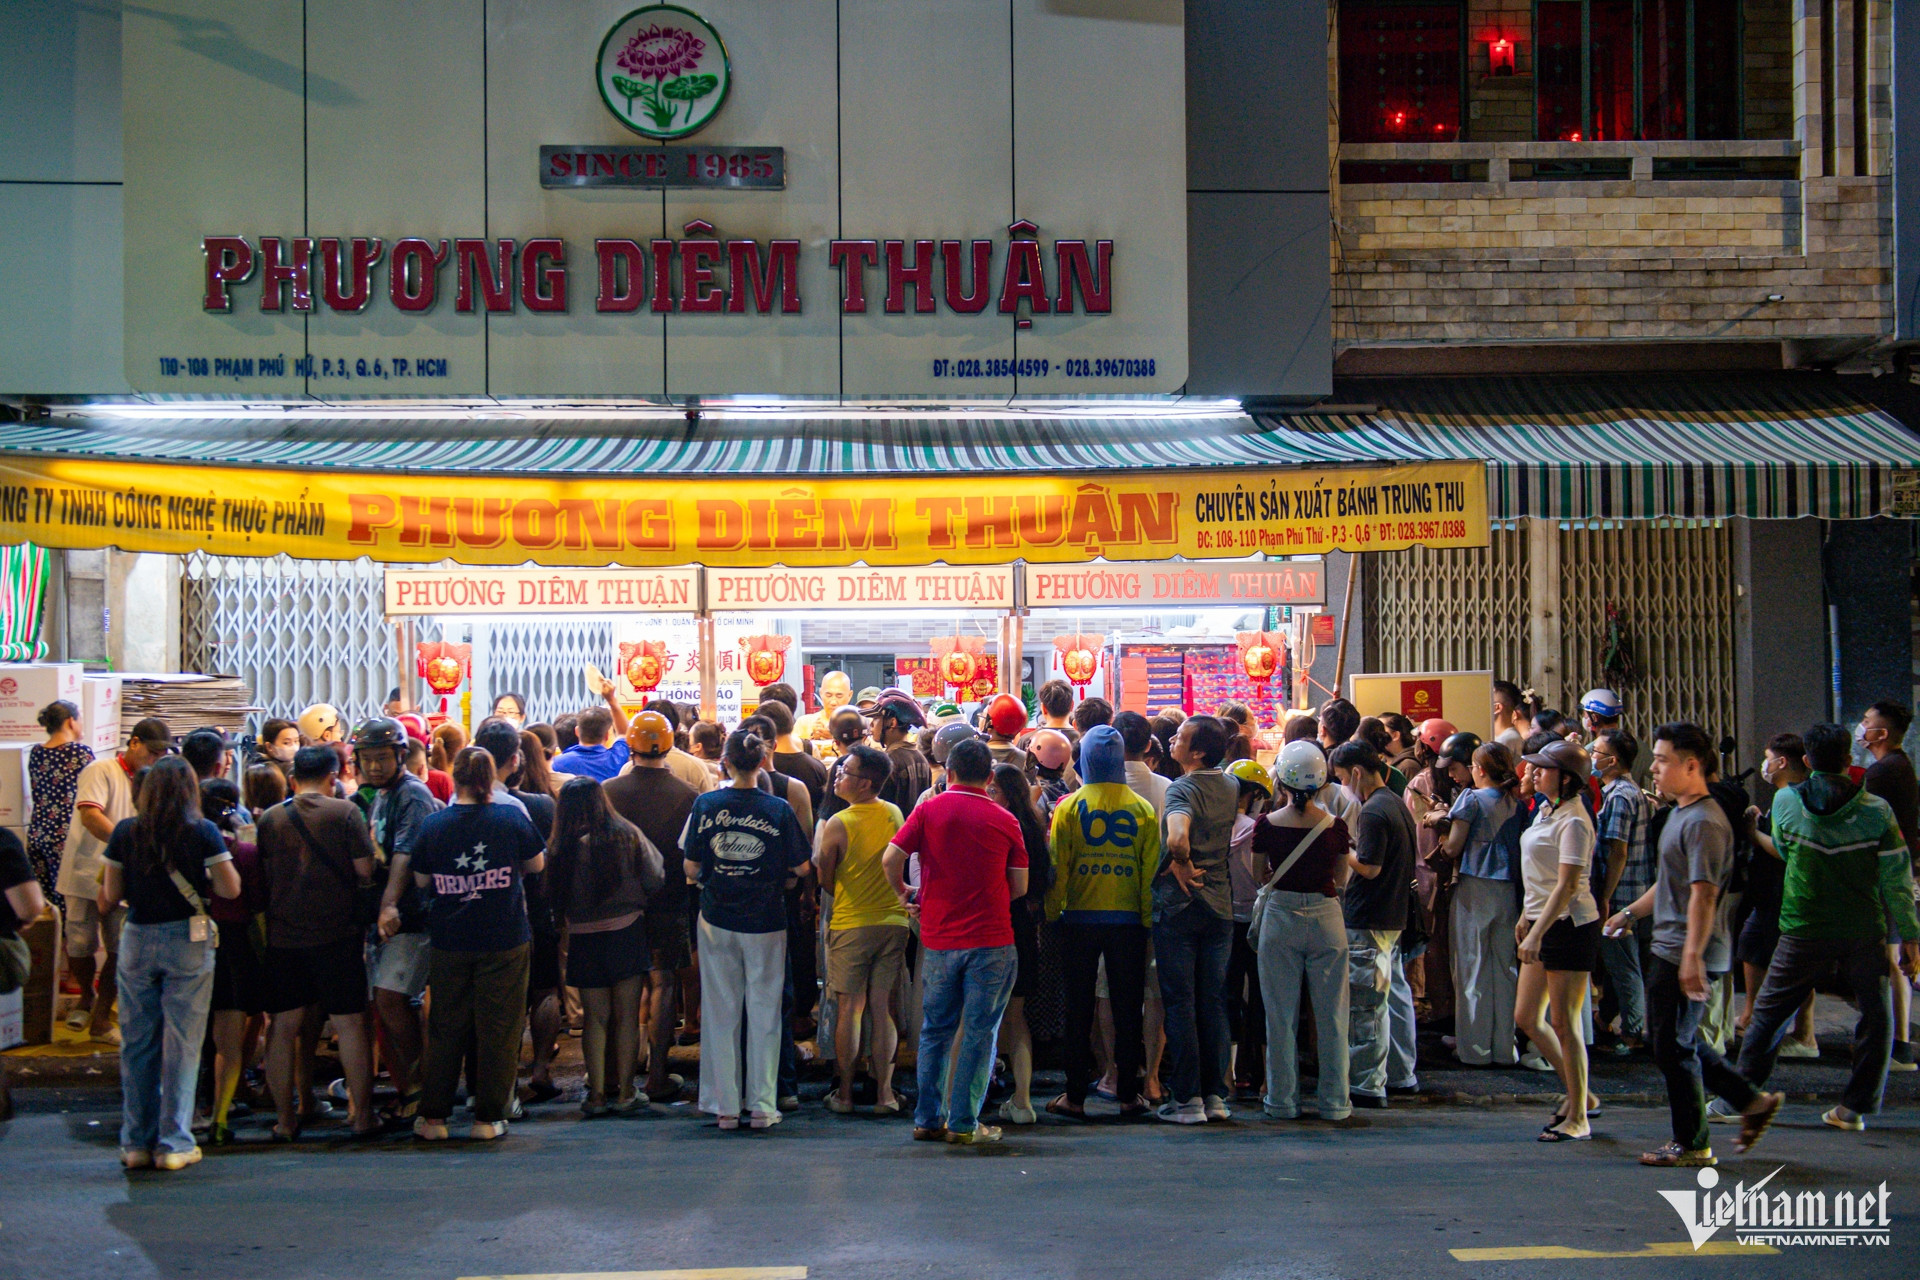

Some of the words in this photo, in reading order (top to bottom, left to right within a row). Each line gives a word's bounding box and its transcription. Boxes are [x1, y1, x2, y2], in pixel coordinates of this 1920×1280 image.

[550, 153, 667, 178] SINCE
[686, 153, 774, 178] 1985
[202, 234, 569, 314] PHƯƠNG
[829, 218, 1114, 330] THUẬN
[159, 357, 209, 377] 110-108
[214, 357, 253, 381] PHẠM
[258, 353, 285, 377] PHÚ
[416, 357, 447, 377] HCM
[1066, 359, 1156, 377] 028.39670388
[0, 486, 28, 523] NG
[34, 487, 54, 524] TY
[60, 488, 106, 527] TNHH
[113, 486, 162, 530] CÔNG
[168, 490, 216, 540] NGHỆ
[222, 496, 267, 541] THỰC
[273, 486, 325, 536] PHẨM
[1195, 483, 1256, 523] CHUYÊN
[1260, 479, 1290, 521] SẢN
[1293, 477, 1332, 520] XUẤT
[1337, 480, 1378, 517] BÁNH
[1381, 482, 1431, 515] TRUNG
[1434, 481, 1464, 513] THU
[347, 493, 676, 552] PHƯƠNG
[915, 483, 1180, 556] THUẬN
[1197, 530, 1213, 549] ĐC:
[1259, 528, 1284, 550] Phạm
[1287, 526, 1303, 546] Phú
[1306, 526, 1324, 545] Thứ
[1332, 525, 1346, 543] P.3
[1355, 524, 1370, 544] Q.6
[1379, 523, 1395, 541] ĐT:
[1398, 520, 1466, 541] 028.3967.0388
[396, 577, 505, 606] PHƯƠNG
[598, 575, 690, 608] THUẬN
[718, 573, 826, 602] PHƯƠNG
[916, 572, 1006, 604] THUẬN
[1036, 570, 1141, 599] PHƯƠNG
[1228, 568, 1318, 602] THUẬN
[737, 617, 754, 626] MINH
[657, 688, 700, 700] THÔNG
[715, 689, 733, 699] ÁO
[1078, 798, 1138, 848] be
